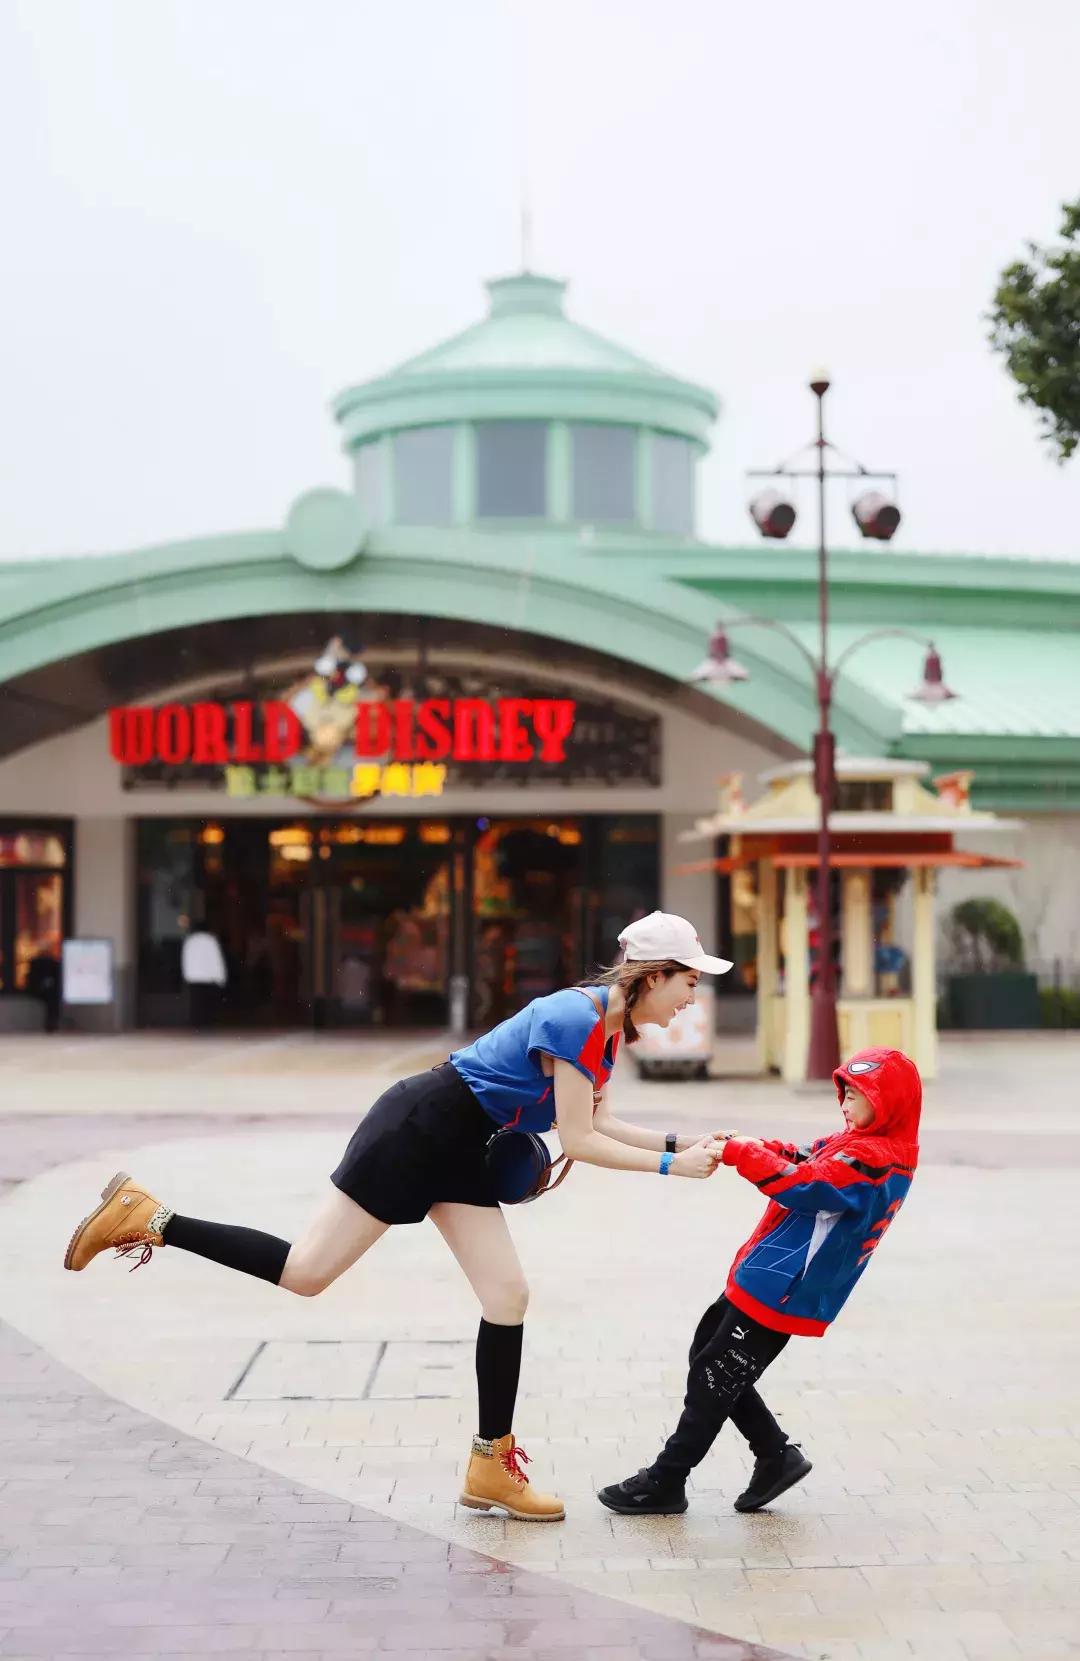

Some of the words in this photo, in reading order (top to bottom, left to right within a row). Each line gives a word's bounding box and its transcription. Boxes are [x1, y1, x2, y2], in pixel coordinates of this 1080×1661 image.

[108, 702, 301, 765] WORLD
[354, 697, 576, 763] DISNEY
[727, 1348, 748, 1367] PUMA
